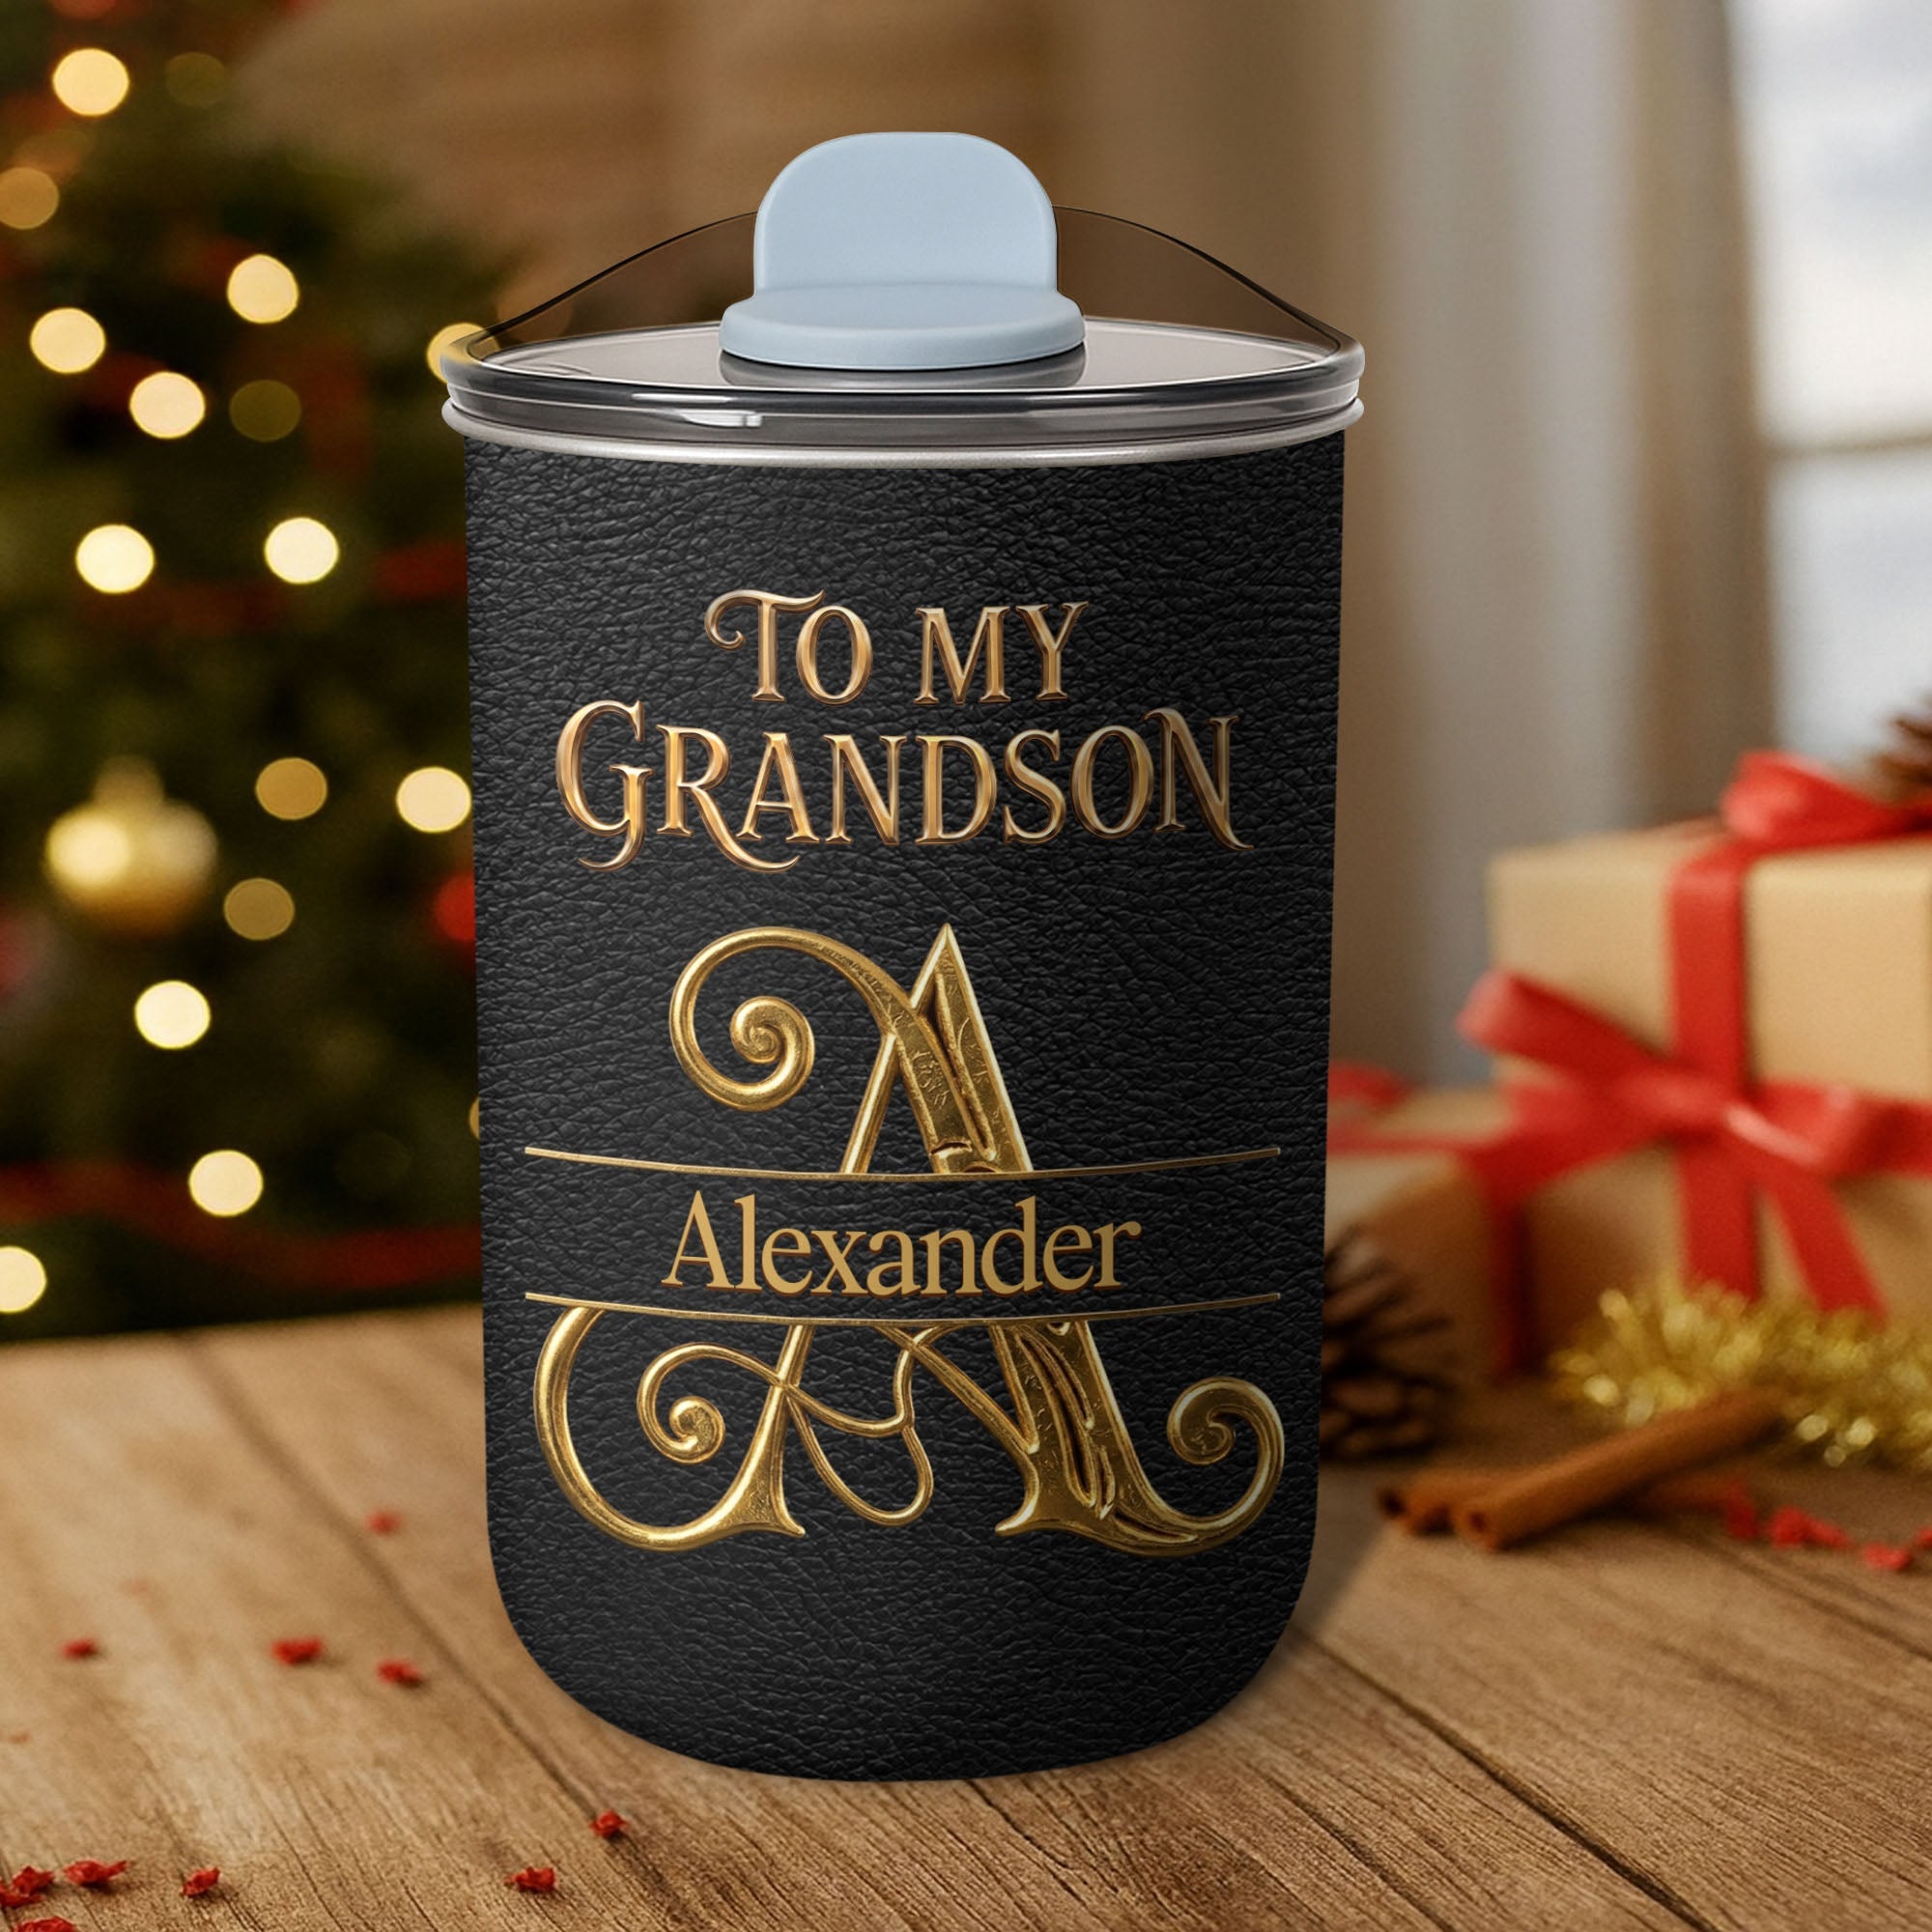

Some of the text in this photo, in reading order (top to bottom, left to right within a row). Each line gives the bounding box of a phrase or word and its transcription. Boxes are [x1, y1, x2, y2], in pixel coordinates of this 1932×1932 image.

[703, 588, 1089, 706] TO MY
[554, 698, 1255, 872] GRANDSON
[660, 1189, 1143, 1299] Alexander
